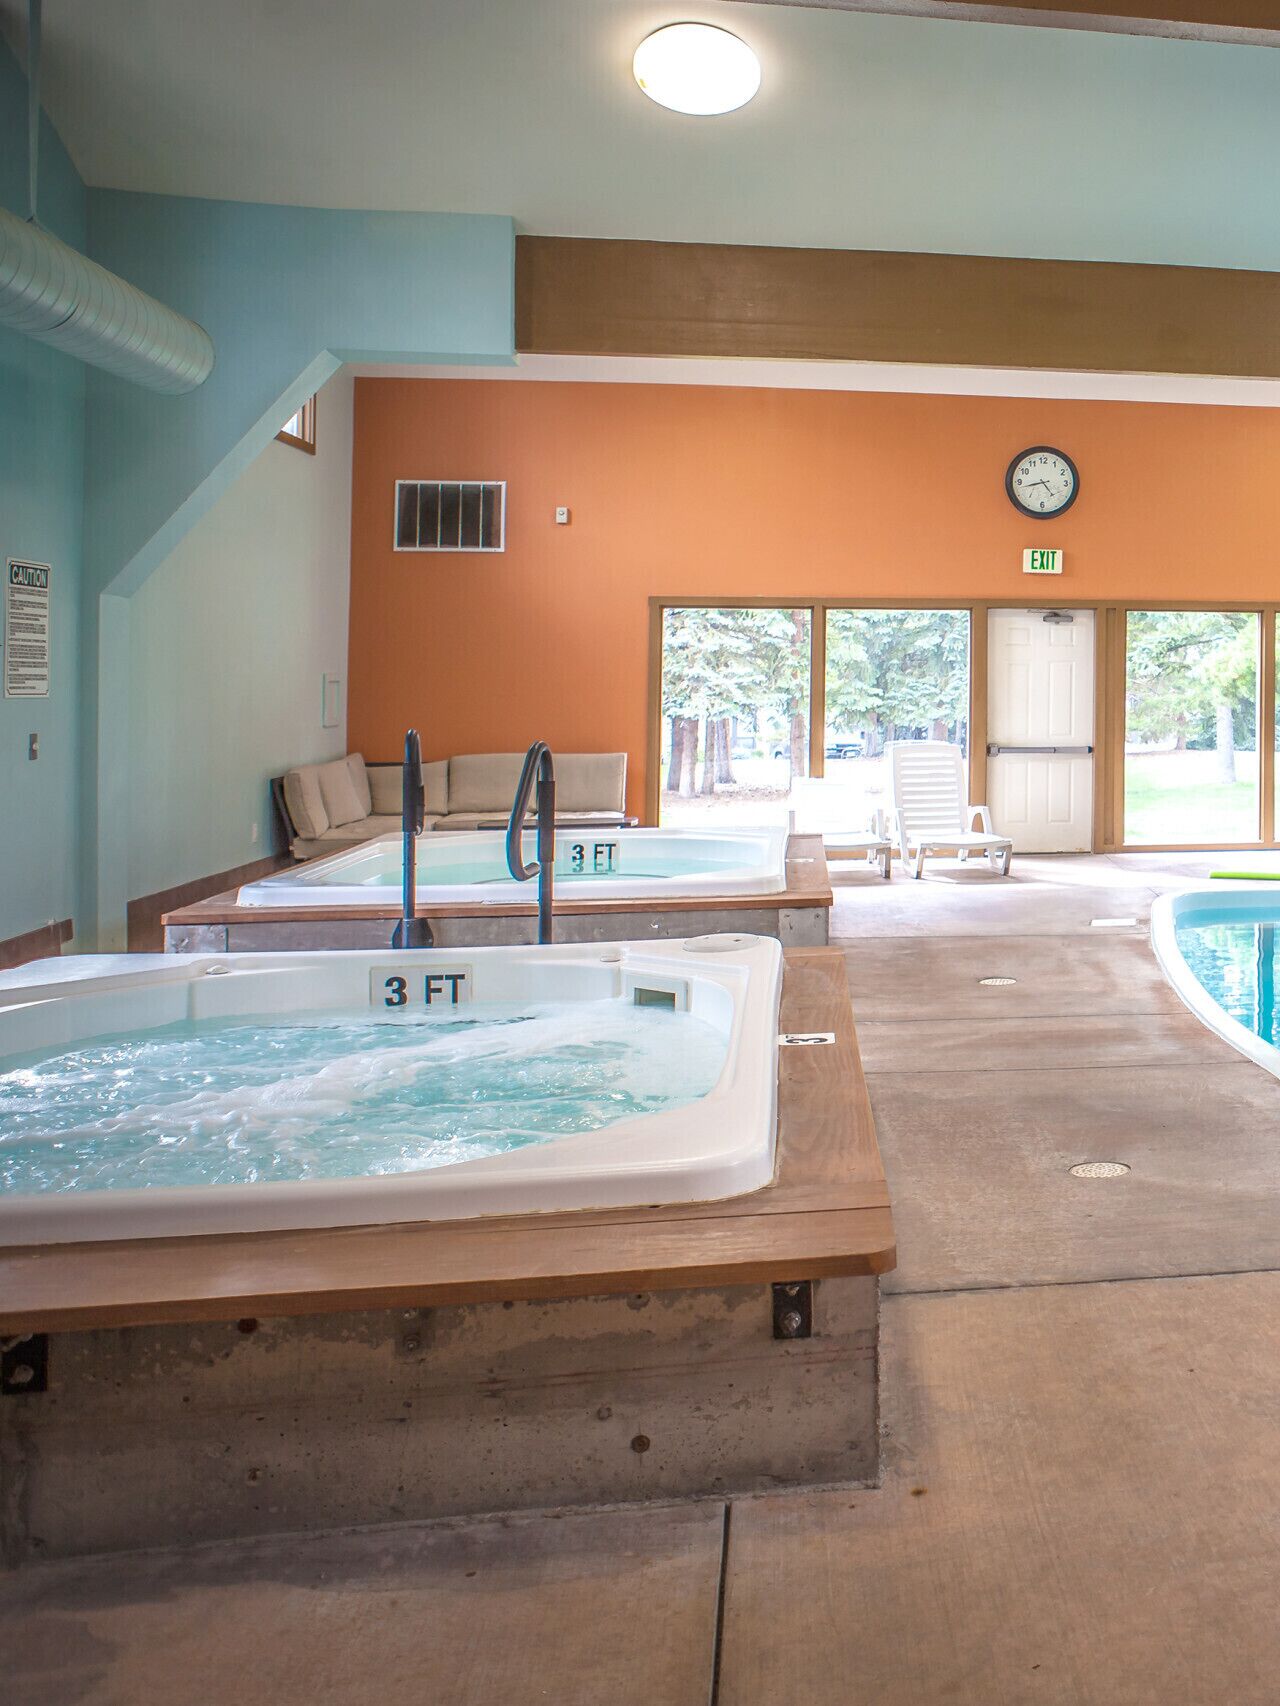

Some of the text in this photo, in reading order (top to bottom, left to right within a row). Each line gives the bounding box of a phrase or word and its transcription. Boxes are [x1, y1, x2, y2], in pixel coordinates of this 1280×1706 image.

[1039, 457, 1048, 465] 12
[1017, 478, 1023, 486] 9
[1039, 501, 1045, 509] 6
[1031, 550, 1057, 570] EXIT
[12, 565, 47, 587] CAUTION
[571, 843, 616, 860] 3 FT
[384, 973, 466, 1007] 3 FT
